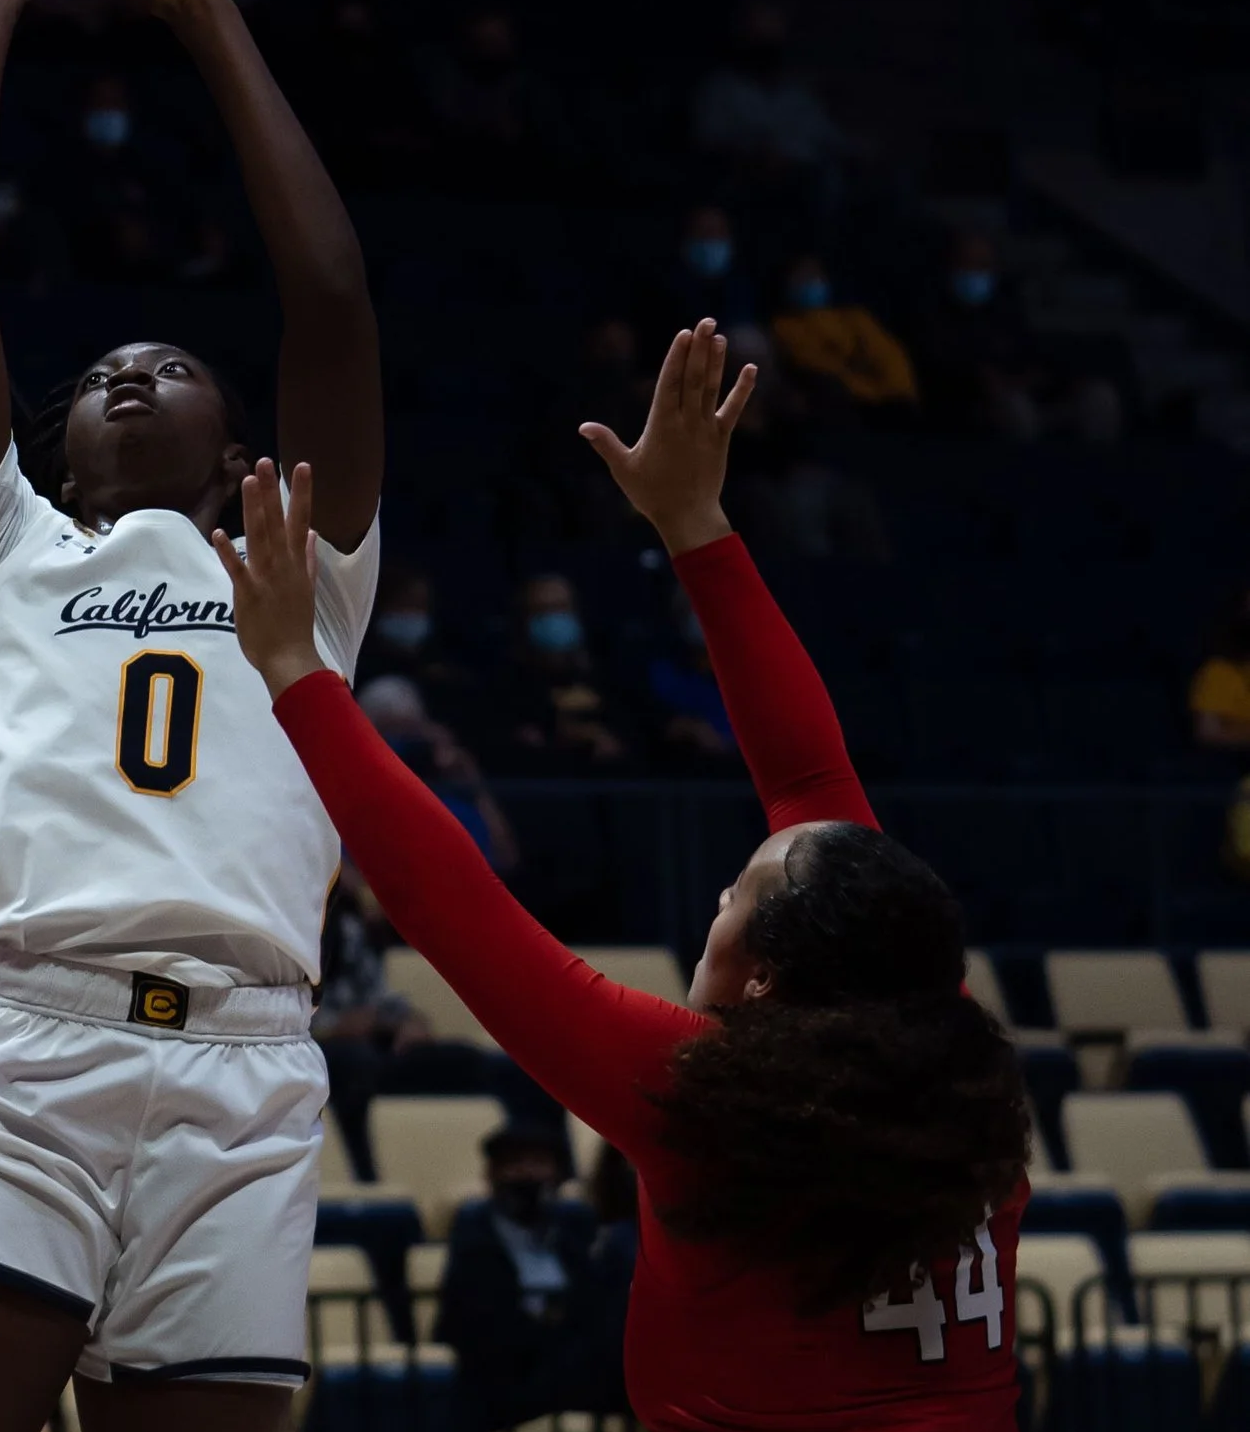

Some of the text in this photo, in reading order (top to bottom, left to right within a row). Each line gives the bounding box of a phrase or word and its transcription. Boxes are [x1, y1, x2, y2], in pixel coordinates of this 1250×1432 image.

[59, 581, 234, 639] Californ
[114, 648, 204, 799] 0
[862, 1201, 1005, 1362] 44
